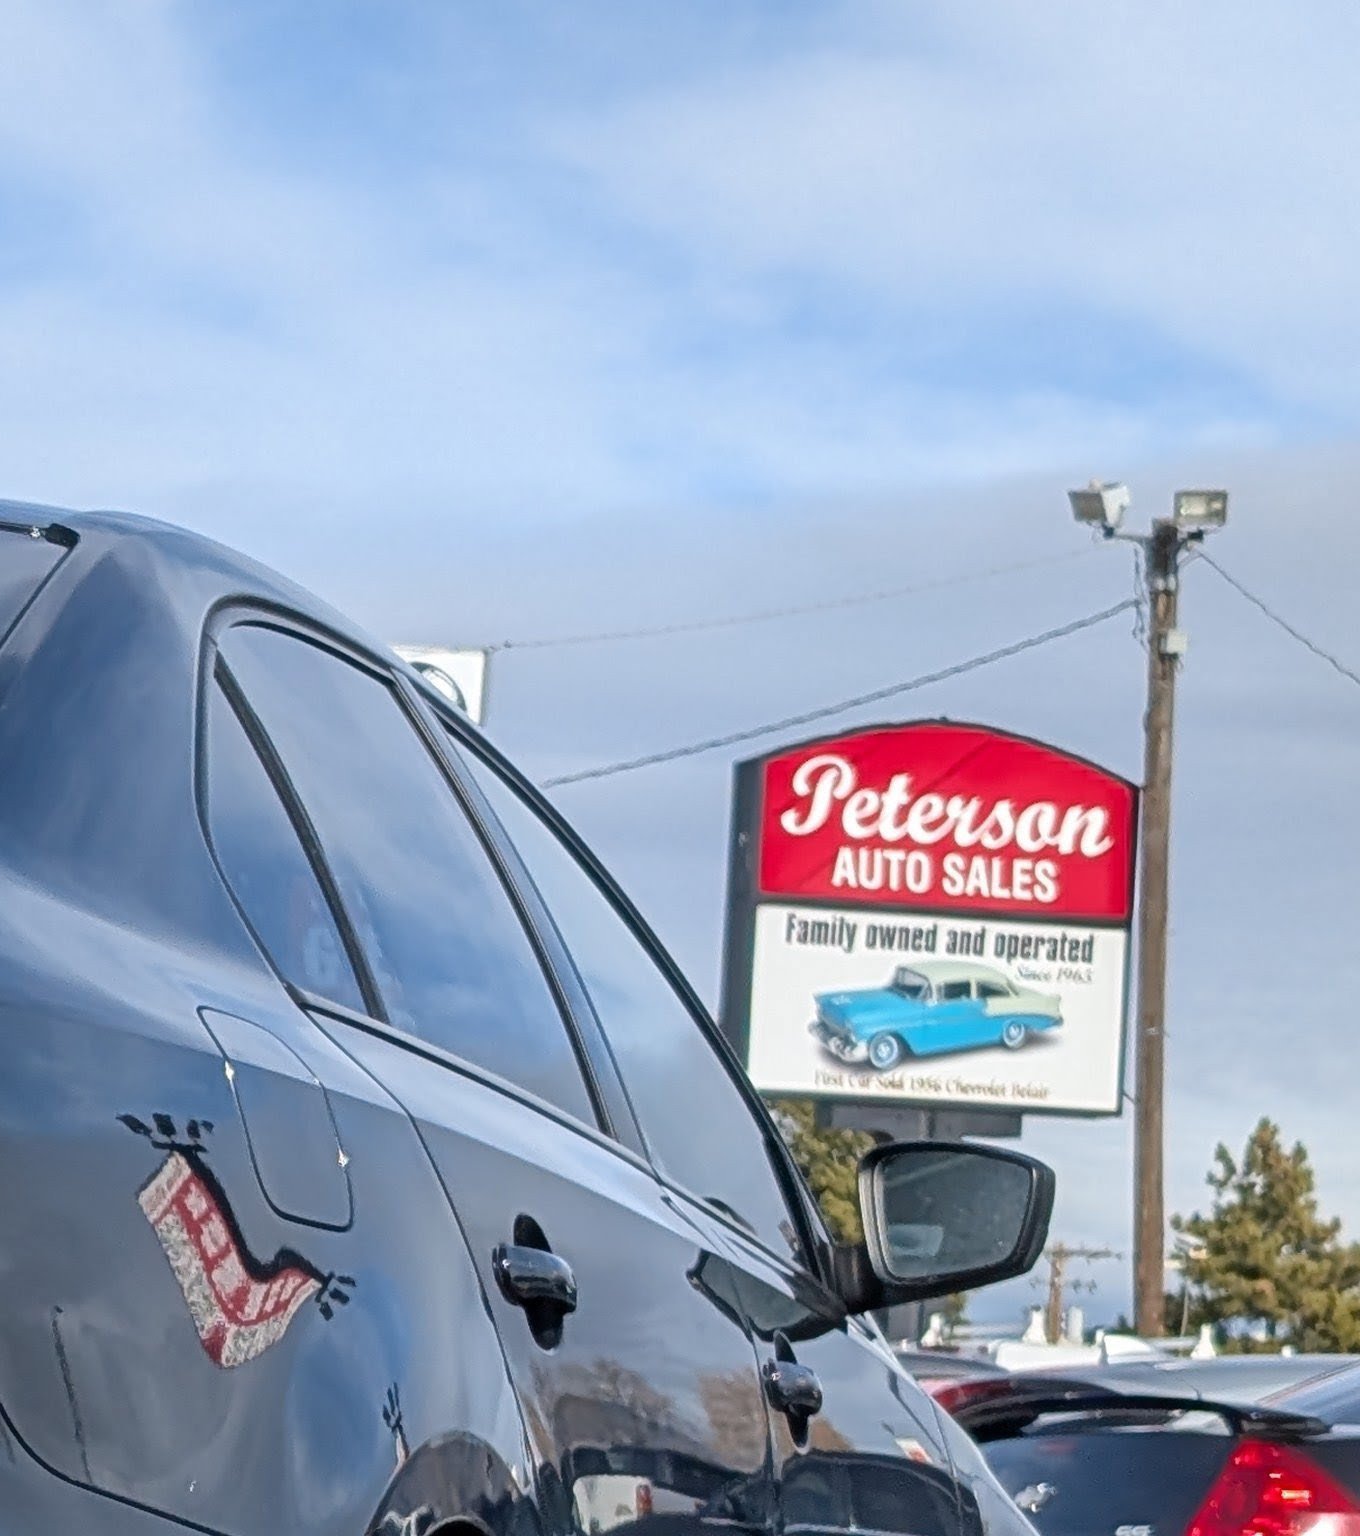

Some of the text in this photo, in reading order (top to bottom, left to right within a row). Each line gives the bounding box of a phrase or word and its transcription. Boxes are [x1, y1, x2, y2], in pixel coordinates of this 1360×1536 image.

[779, 753, 1115, 858] Peterson
[831, 845, 1060, 903] AUTO SALES
[785, 912, 1095, 965] Family owned and operated
